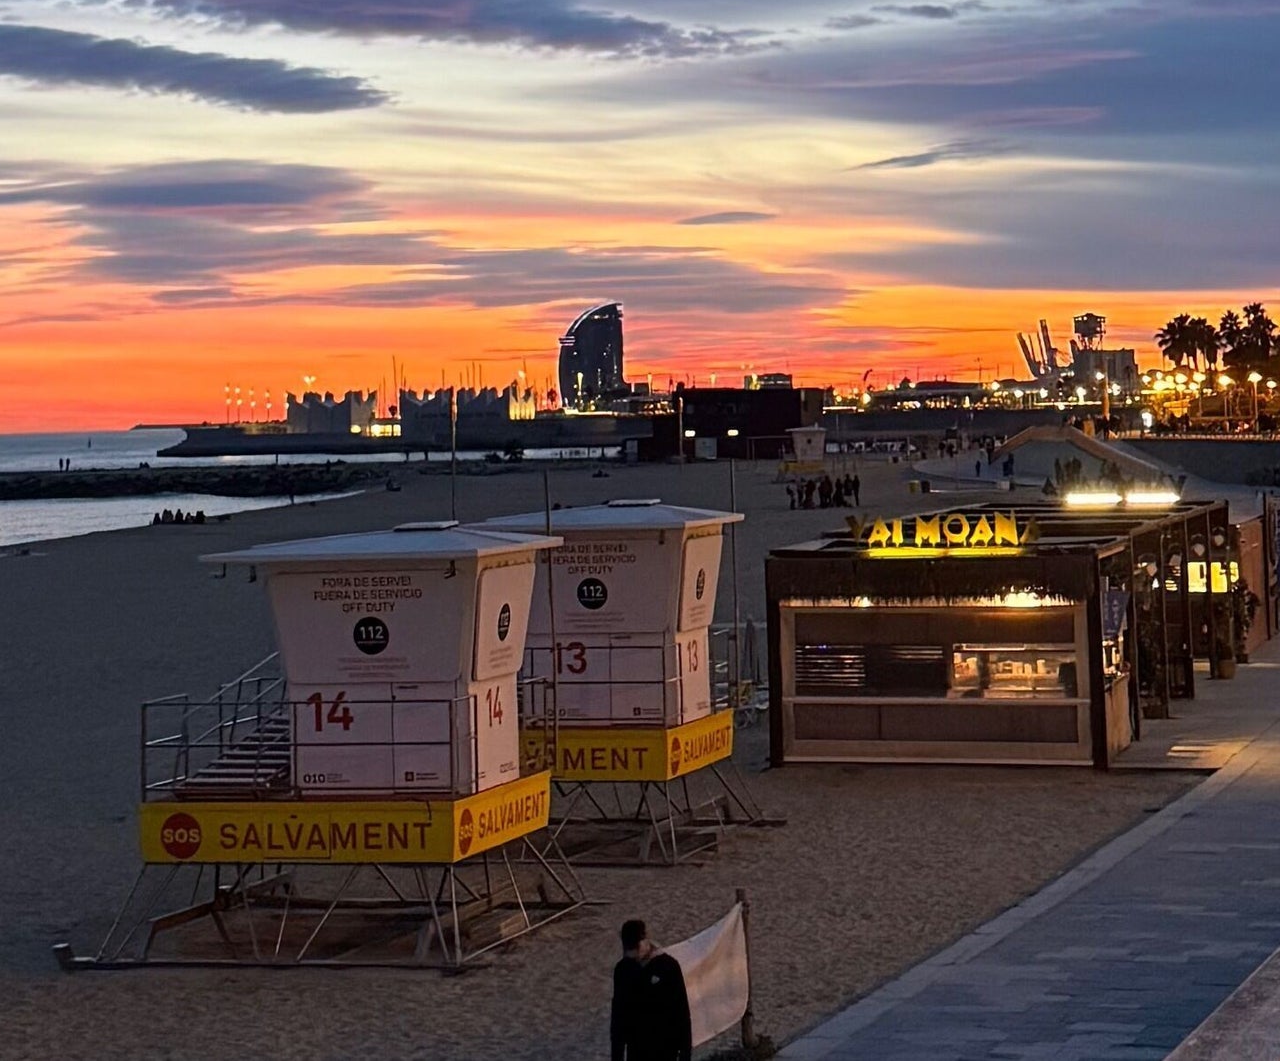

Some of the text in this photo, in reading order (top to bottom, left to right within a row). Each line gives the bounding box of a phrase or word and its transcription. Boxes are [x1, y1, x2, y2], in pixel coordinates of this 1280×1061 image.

[354, 577, 369, 587] DE
[353, 590, 369, 600] DE
[370, 589, 423, 599] SERVICIO
[582, 585, 604, 598] 112
[365, 602, 395, 612] DUTY
[359, 625, 385, 640] 112
[556, 641, 587, 675] 13
[687, 639, 699, 673] 13
[306, 691, 354, 732] 14
[486, 685, 504, 727] 14
[303, 773, 327, 784] 010
[478, 790, 548, 839] SALVAMENT
[162, 827, 201, 844] SOS
[219, 822, 433, 851] SALVAMENT
